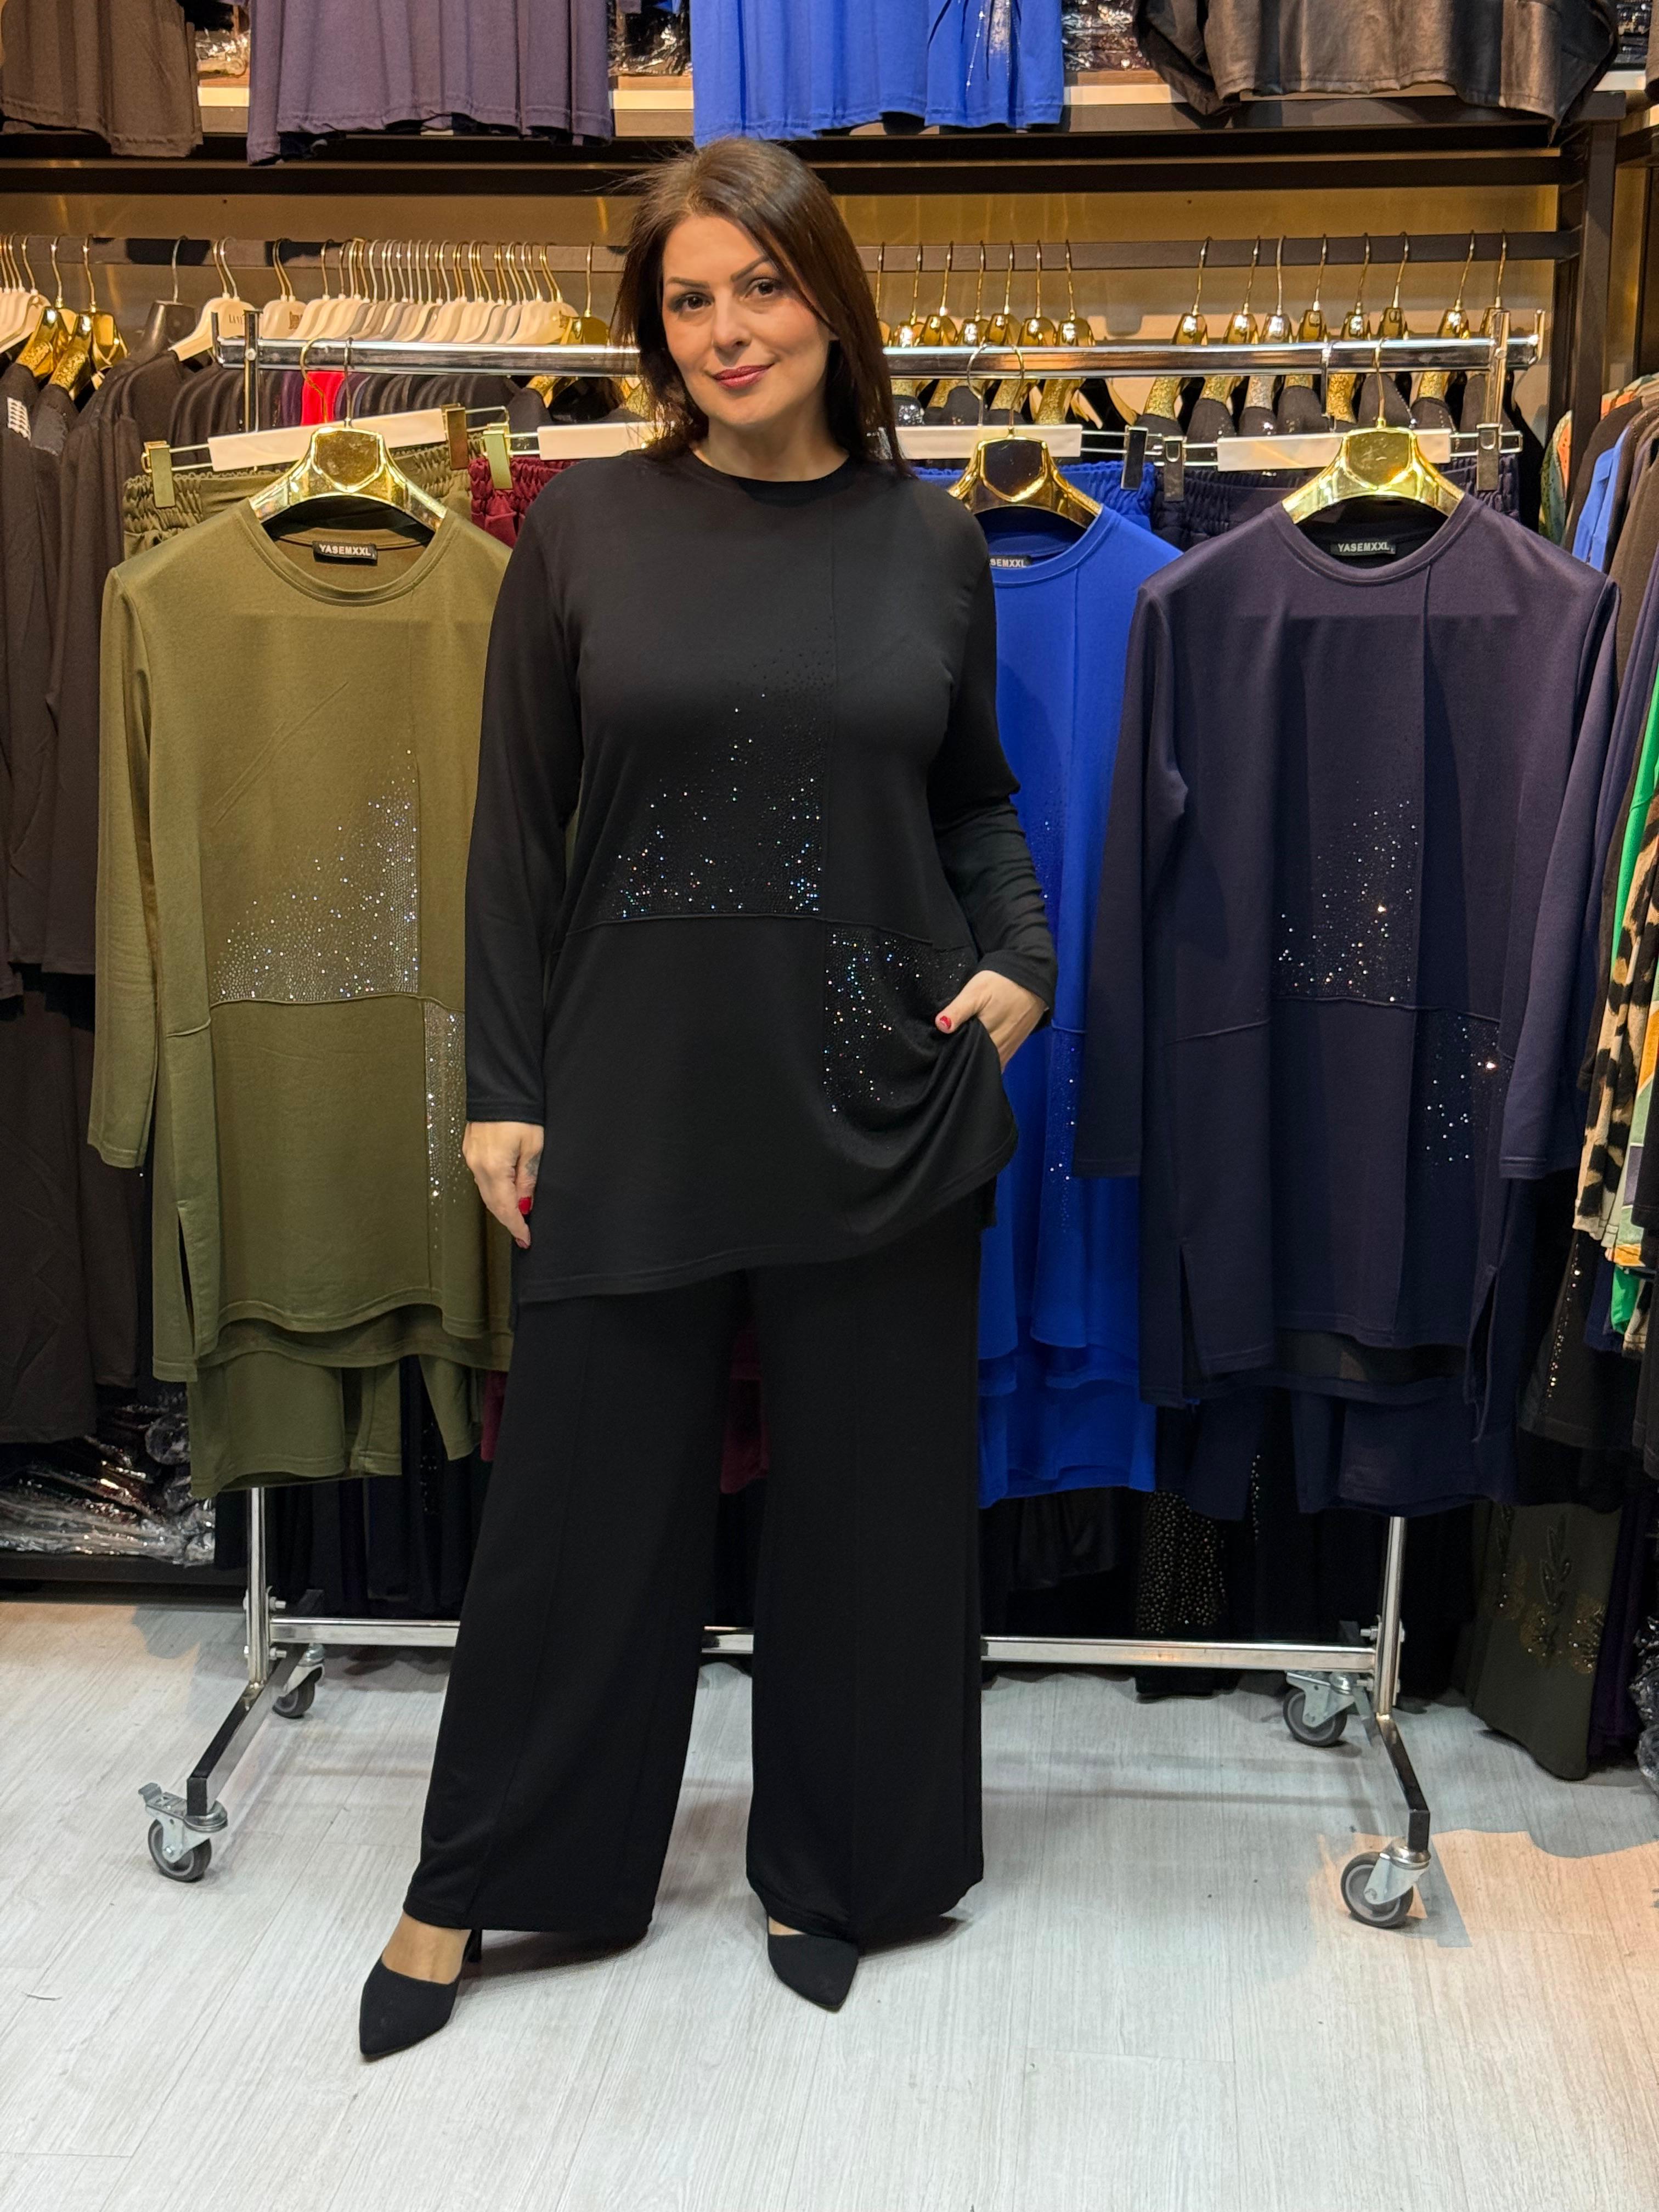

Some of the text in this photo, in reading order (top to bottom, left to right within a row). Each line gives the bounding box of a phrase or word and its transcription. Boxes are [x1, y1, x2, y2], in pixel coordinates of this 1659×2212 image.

[319, 544, 371, 556] YASEMXXL
[1338, 541, 1390, 552] YASEMXXL
[990, 558, 1026, 568] SEMXXL
